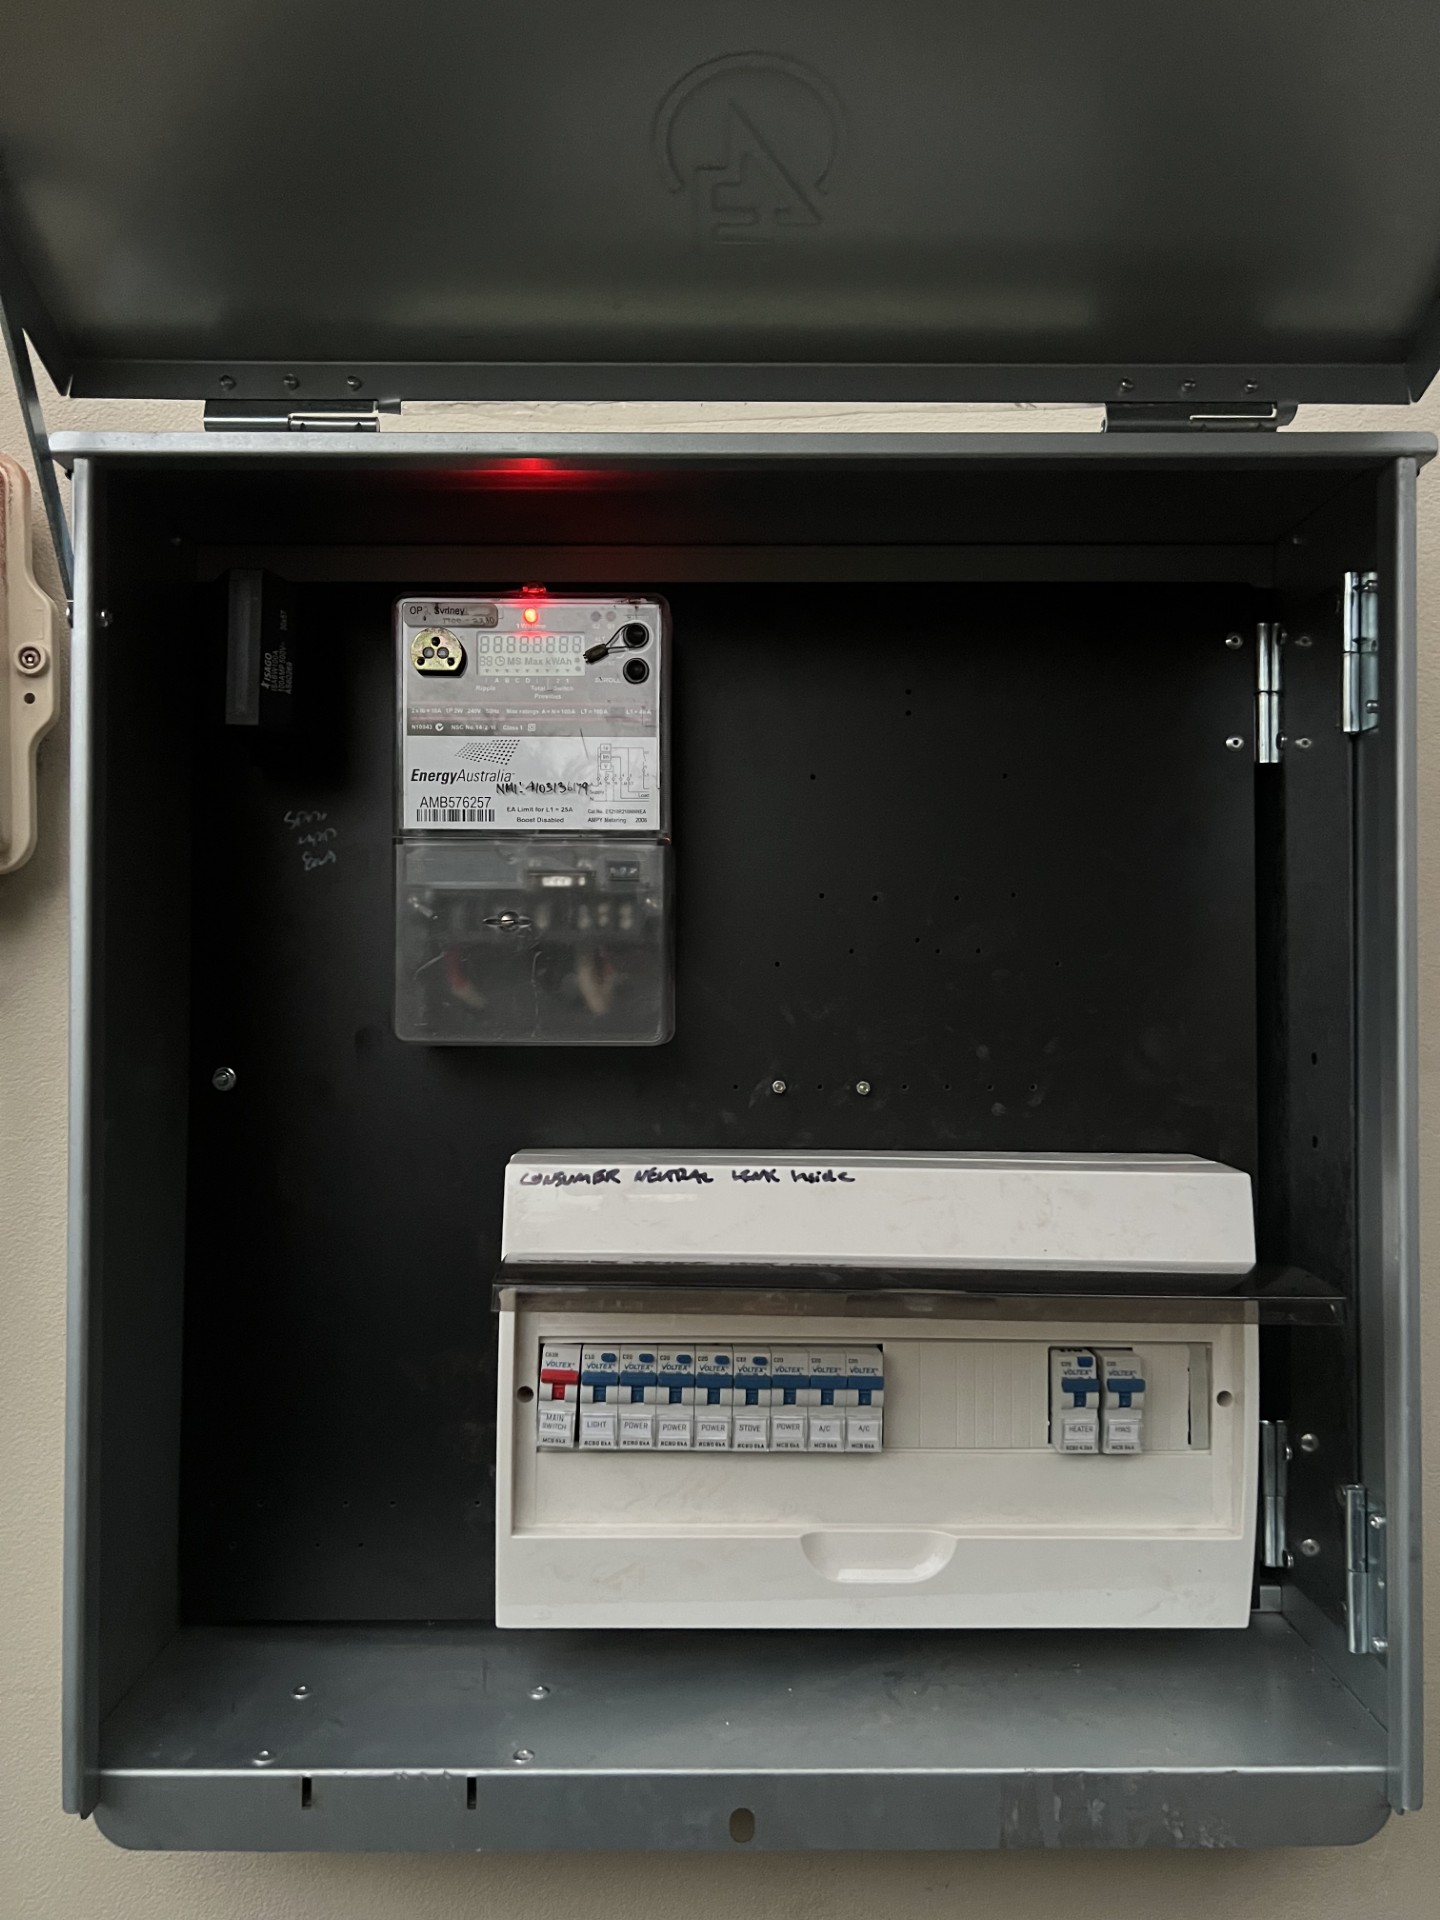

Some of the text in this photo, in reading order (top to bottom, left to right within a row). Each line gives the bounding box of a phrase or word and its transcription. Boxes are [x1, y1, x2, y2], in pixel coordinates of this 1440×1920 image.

[410, 768, 513, 784] EnergyAustralia
[419, 796, 493, 809] AMB576257
[519, 1168, 622, 1187] CONSUMER
[634, 1167, 715, 1184] NEUTRAL
[546, 1413, 564, 1422] MAIN
[541, 1422, 566, 1431] SWITCH
[624, 1421, 648, 1429] POWER
[701, 1424, 725, 1432] POWER
[738, 1424, 760, 1432] STOVE
[776, 1423, 800, 1431] POWER
